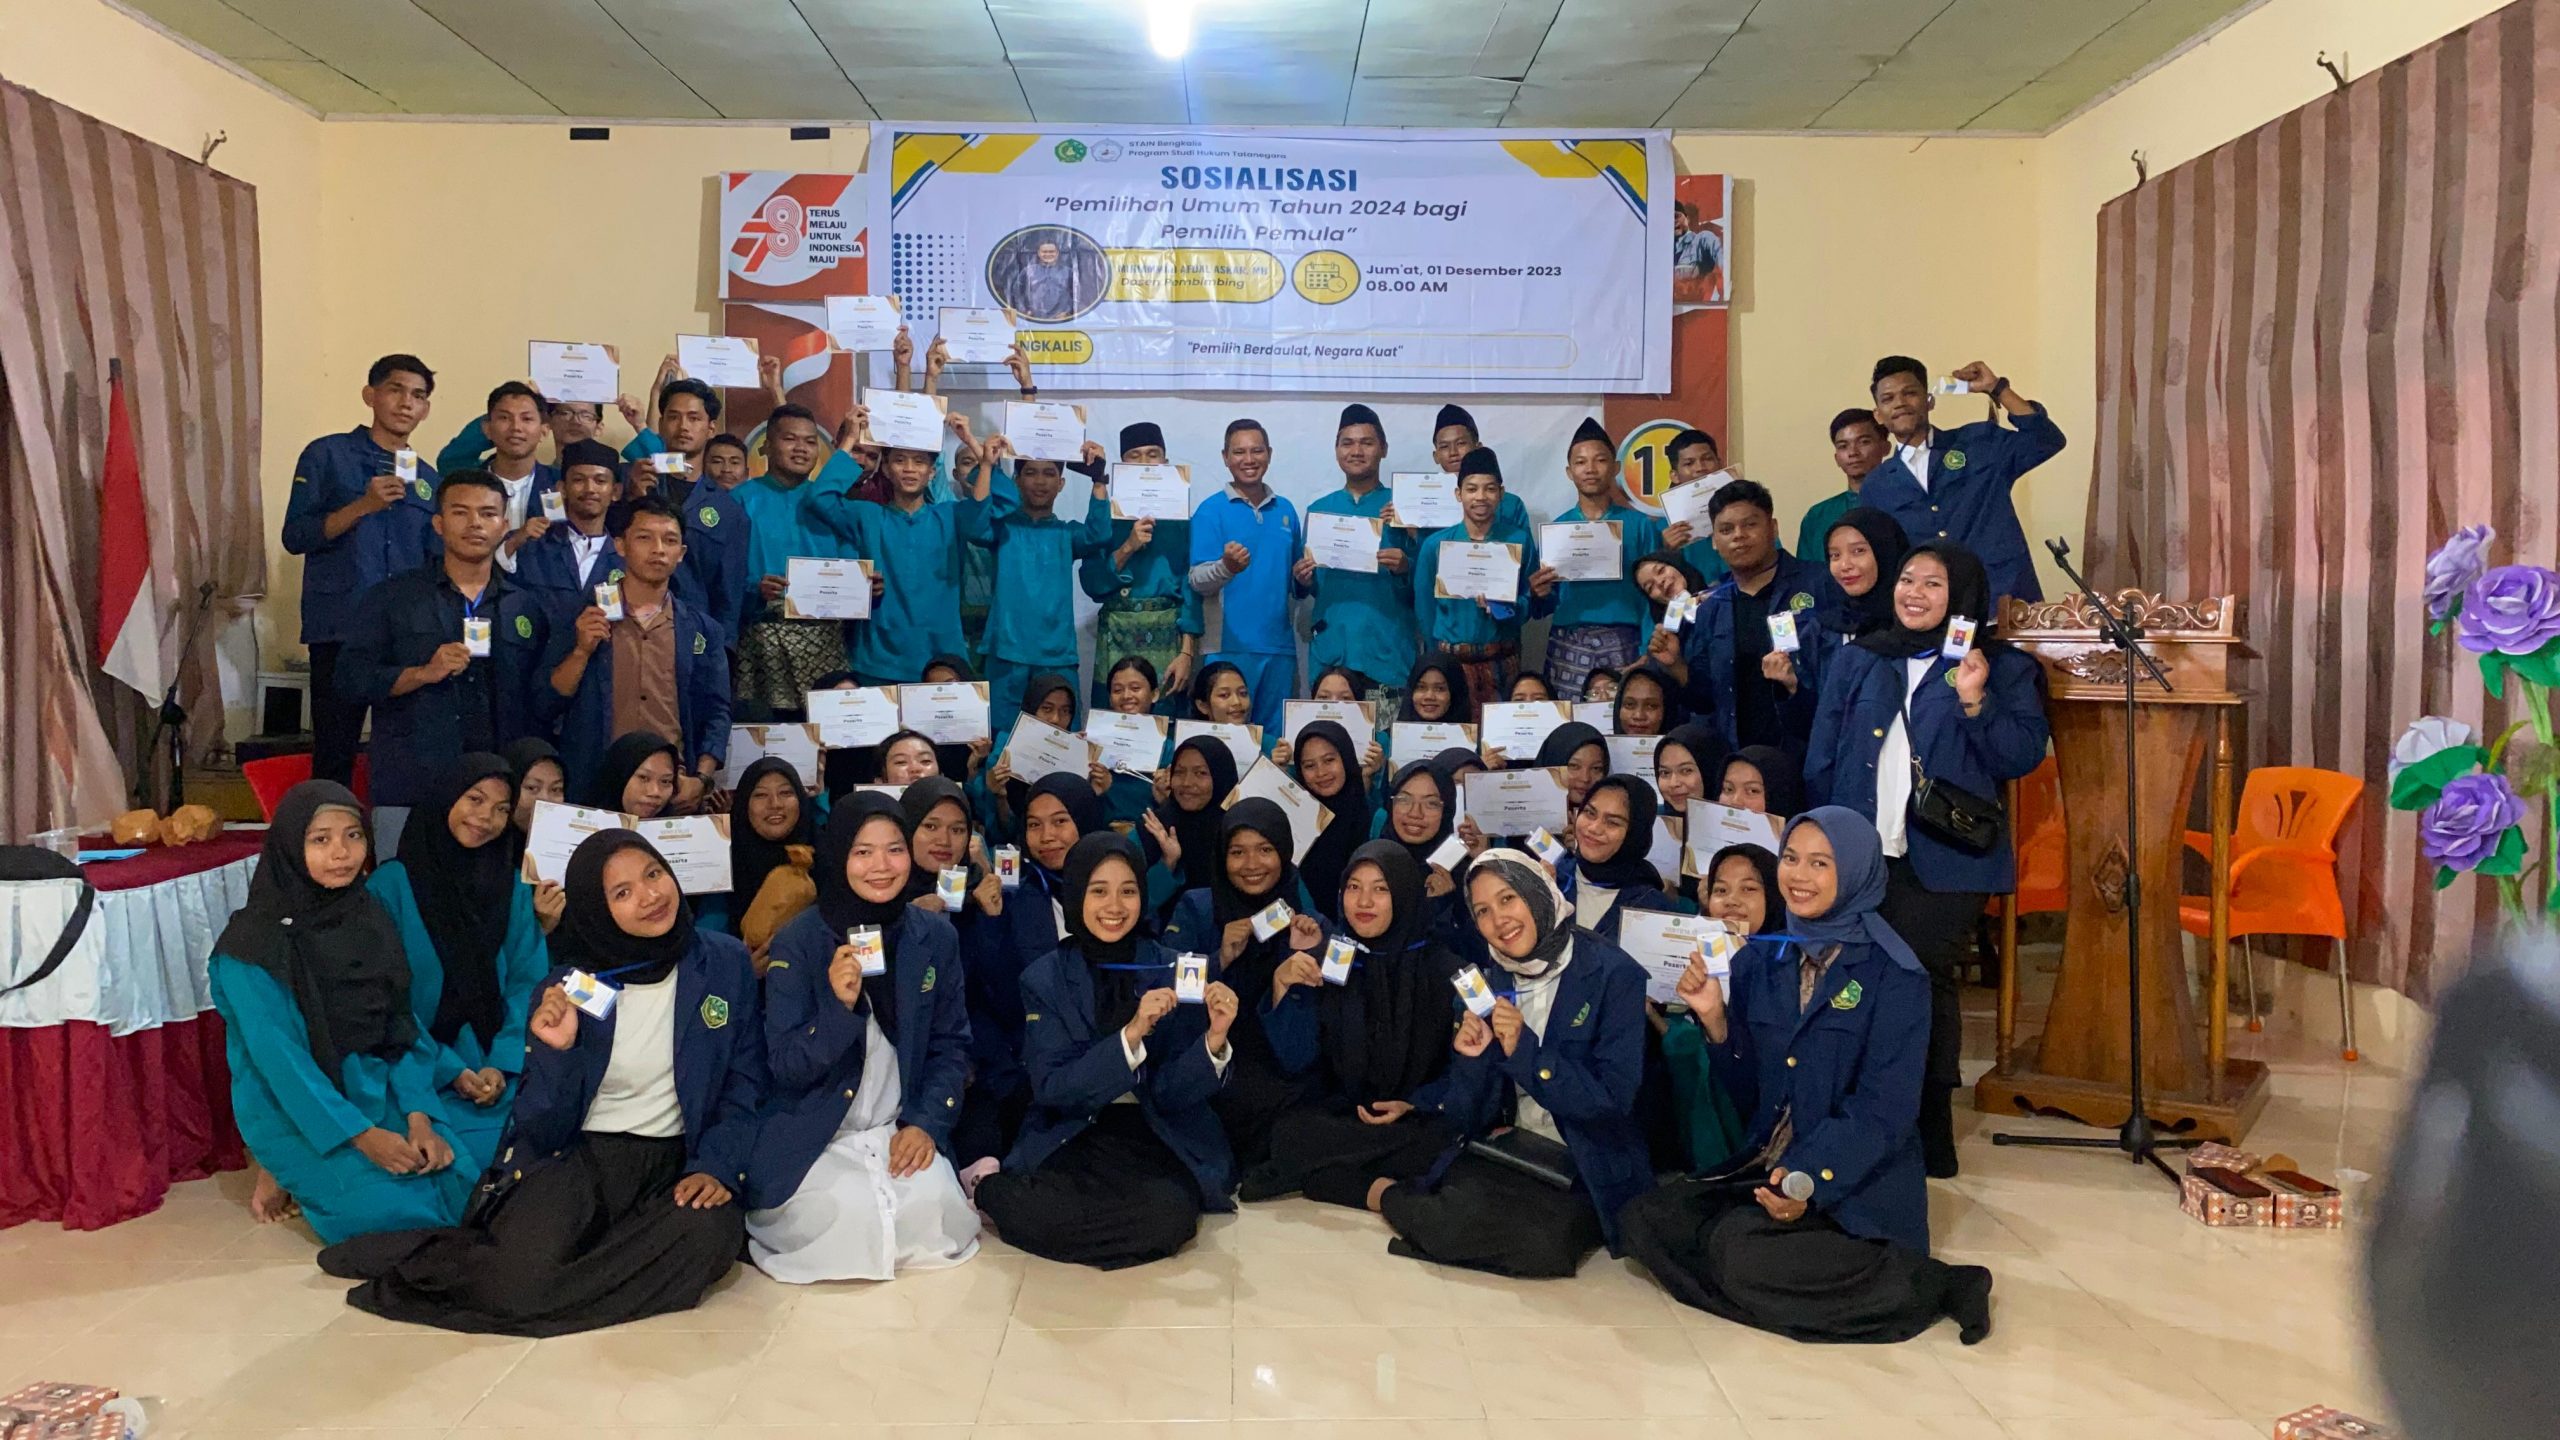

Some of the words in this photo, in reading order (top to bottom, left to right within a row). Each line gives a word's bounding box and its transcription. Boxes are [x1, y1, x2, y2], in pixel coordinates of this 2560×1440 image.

[1157, 140, 1202, 149] Bengkalis
[1129, 150, 1169, 158] Program
[1161, 166, 1357, 192] SOSIALISASI
[809, 209, 840, 217] TERUS
[1181, 198, 1260, 214] Umum
[1269, 199, 1343, 215] Tahun
[1349, 200, 1406, 216] 2024
[1413, 200, 1468, 221] bagi
[809, 221, 847, 229] MELAJU
[809, 232, 842, 240] UNTUK
[1161, 224, 1247, 240] Pemilih
[809, 244, 861, 252] INDONESIA
[1427, 265, 1442, 275] 01
[1445, 266, 1523, 276] Desember
[1527, 266, 1562, 276] 2023
[1366, 280, 1416, 292] 08.00
[1420, 281, 1448, 293] AM
[1017, 340, 1082, 353] NGKALIS
[1243, 343, 1311, 357] Berdaulat,
[1314, 345, 1363, 360] Negara
[1633, 446, 1673, 496] 1
[1663, 961, 1686, 969] Pesert
